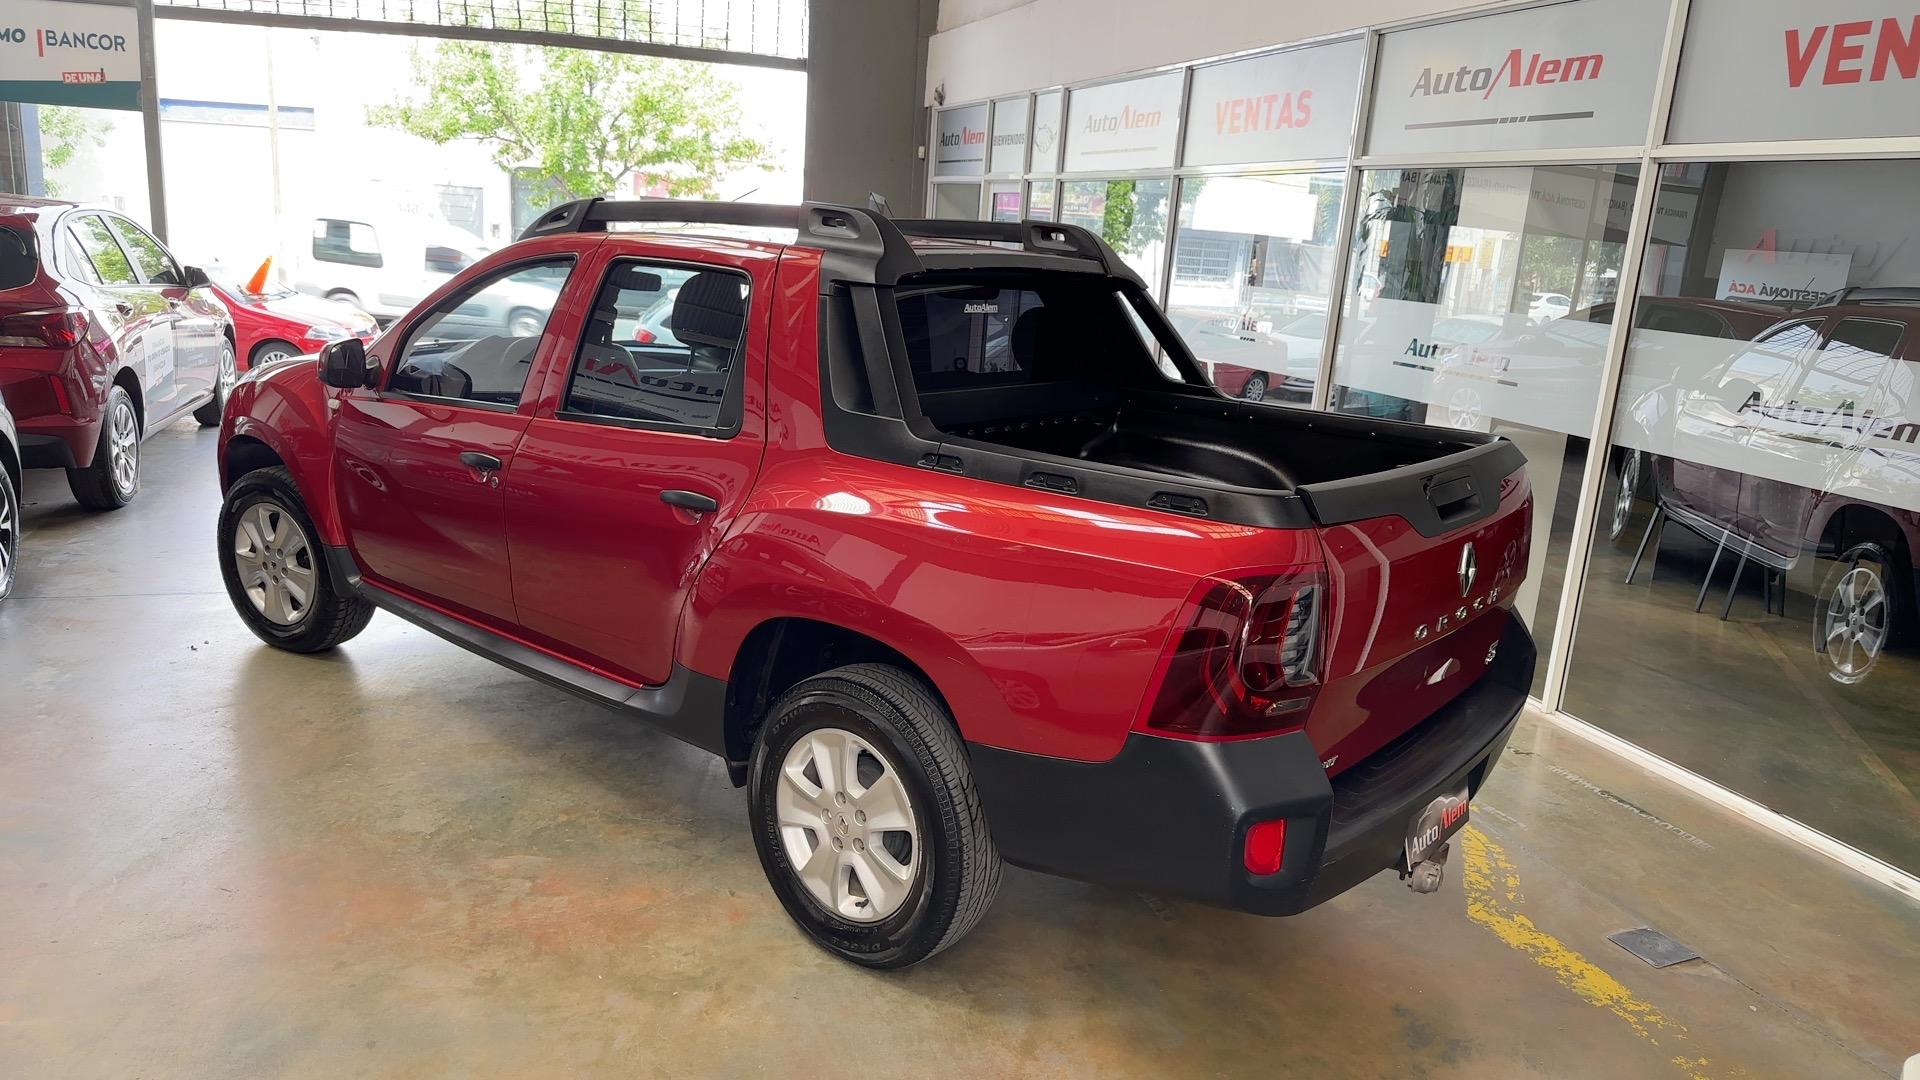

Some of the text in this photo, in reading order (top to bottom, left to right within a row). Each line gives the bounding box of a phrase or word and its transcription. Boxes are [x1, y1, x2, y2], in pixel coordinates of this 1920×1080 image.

[45, 30, 126, 52] BANCOR
[1785, 14, 1920, 88] VEN
[1215, 90, 1314, 135] VENTAS
